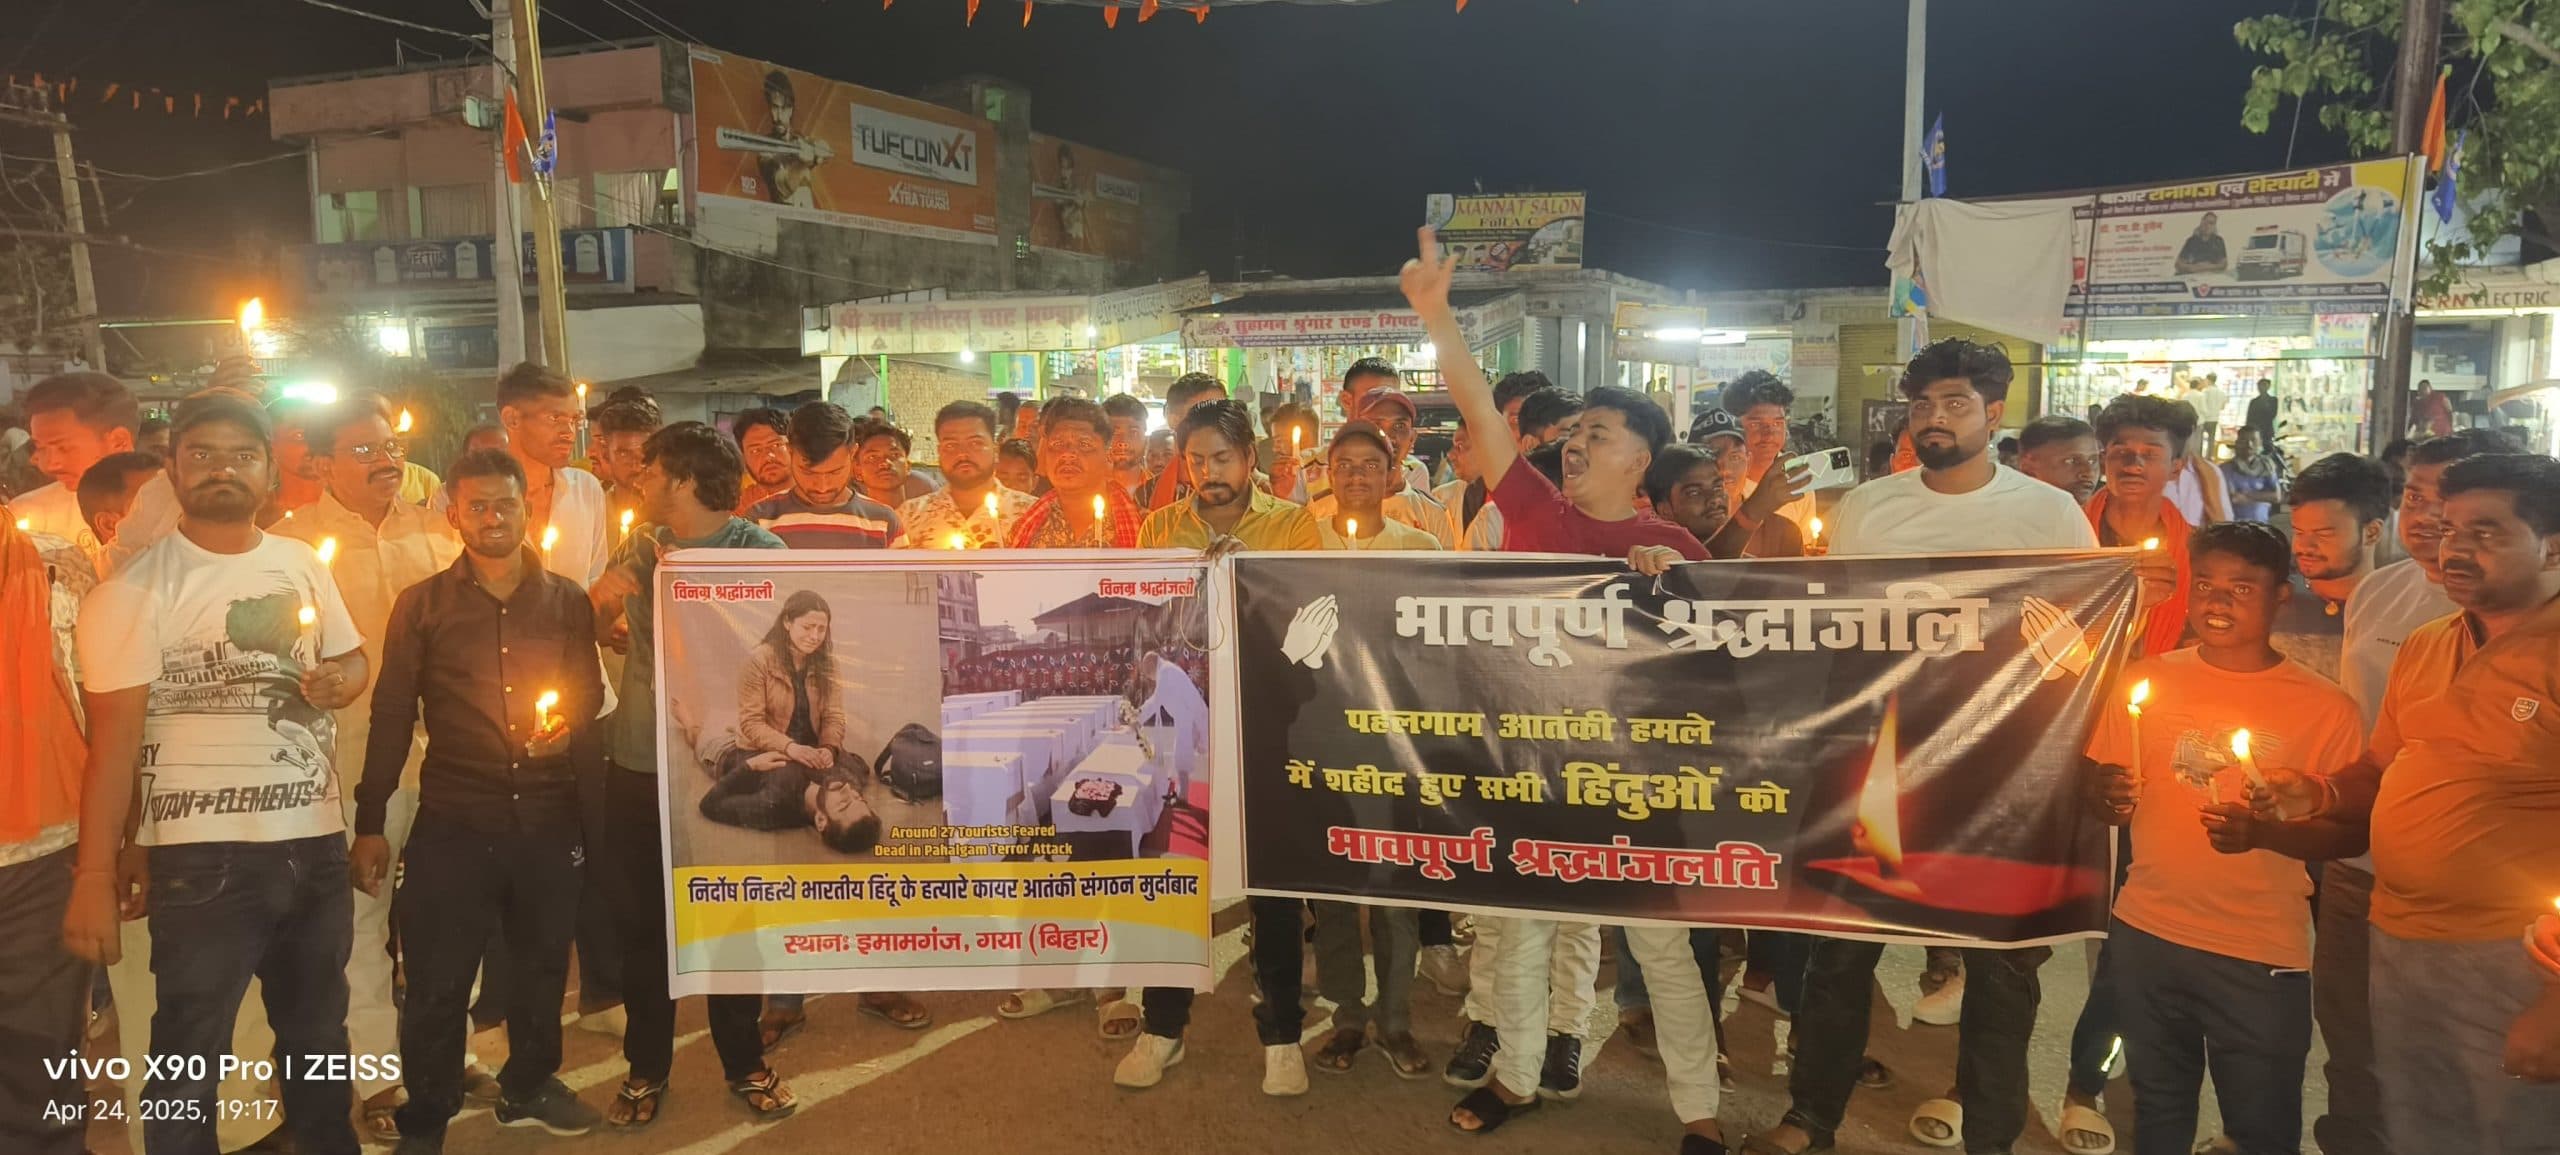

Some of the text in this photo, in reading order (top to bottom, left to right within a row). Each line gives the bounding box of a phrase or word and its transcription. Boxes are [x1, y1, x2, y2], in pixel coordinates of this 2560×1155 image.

[1457, 198, 1581, 216] MANNAT SALON
[673, 580, 773, 601] विनम्र श्रद्धांजली
[1098, 578, 1136, 597] विनम्र
[1396, 582, 1989, 667] भावपूर्ण श्रद्धांजलि
[1344, 708, 1716, 746] पहलगाम आतंकी हमले
[1285, 759, 1789, 821] में शहीद हुए सभी हिंदुओं को
[891, 824, 1056, 839] Around 27 Tourists Feared
[874, 843, 1073, 859] Dead in Pahalgam Terror Attack
[1327, 825, 1495, 881] भावपूर्ण
[687, 869, 1199, 907] निर्दोष निहत्थे भारतीय हिंदू के हत्यारे कायर आतंकी संगठन मुर्दाबाद
[855, 926, 970, 955] इमामगंज,
[975, 931, 1022, 951] गया
[1028, 920, 1109, 957] (बिहार)
